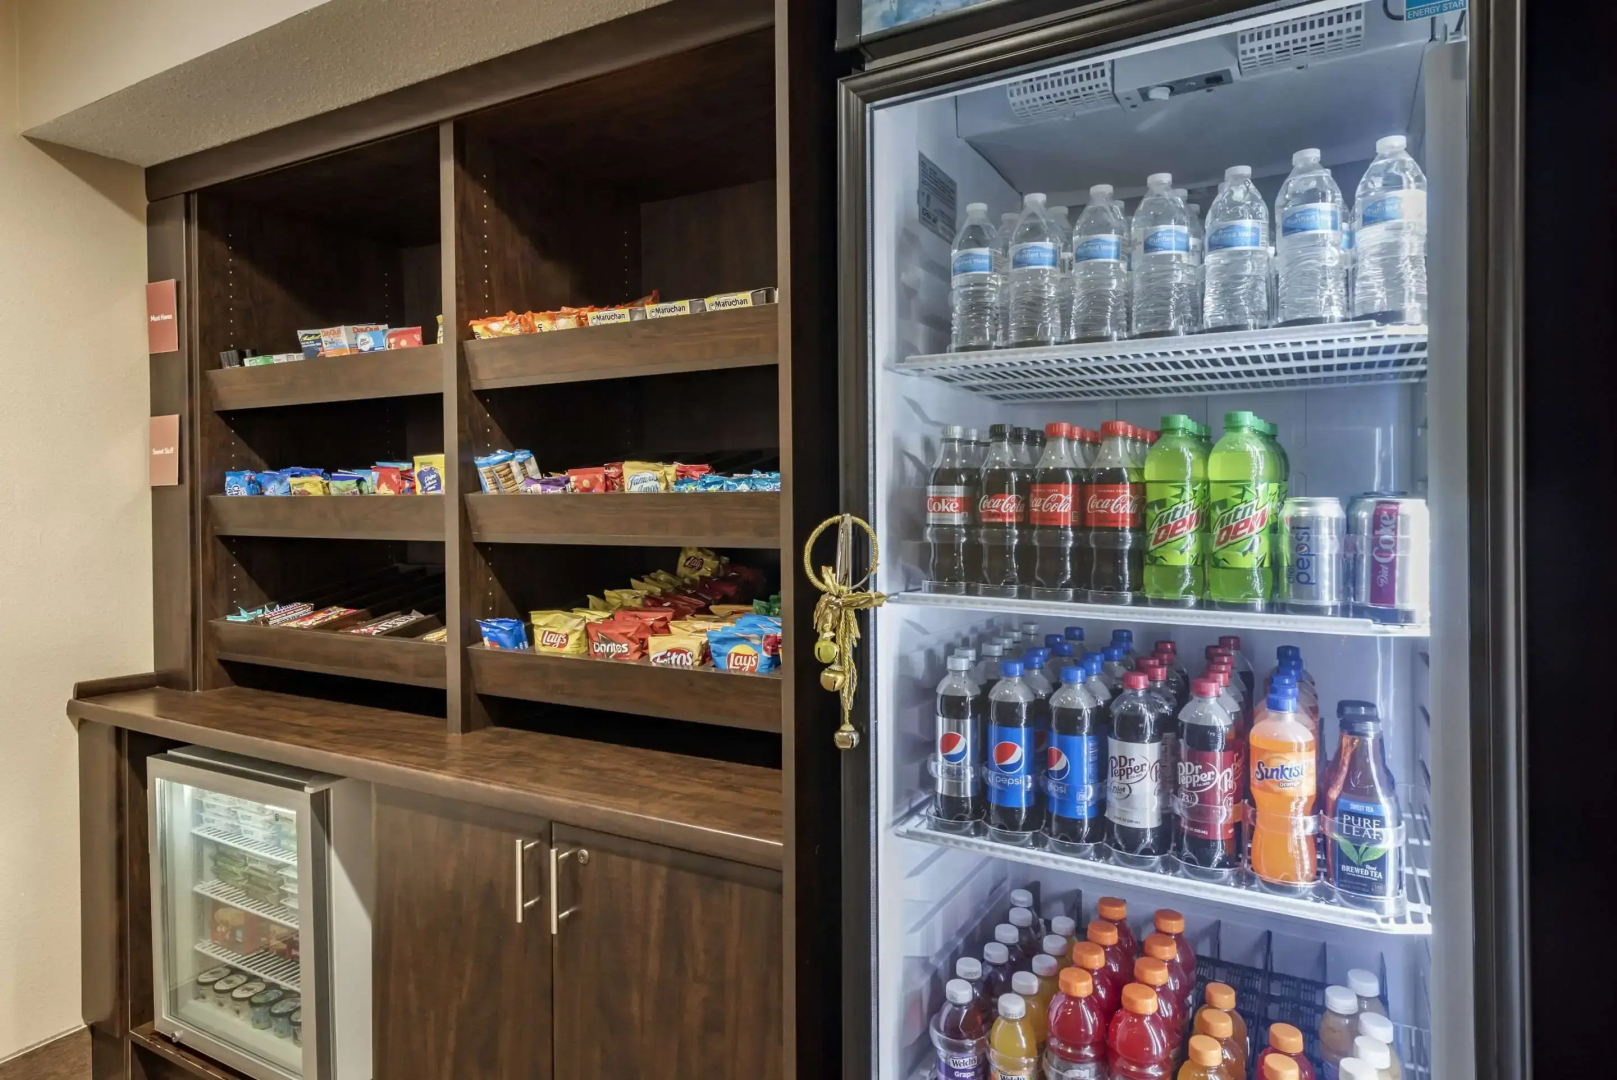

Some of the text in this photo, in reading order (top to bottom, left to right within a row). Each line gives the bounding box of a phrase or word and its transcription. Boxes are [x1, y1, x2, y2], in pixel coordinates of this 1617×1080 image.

[1408, 1, 1464, 19] ENERGY STAR
[655, 305, 686, 315] Maruchan
[714, 298, 748, 307] Maruchan
[596, 312, 626, 321] Maruchan
[627, 475, 658, 490] Famous
[927, 497, 959, 512] Coke
[979, 494, 1025, 513] Coca-Cola
[1087, 494, 1137, 513] Coca-Cola
[1292, 526, 1316, 585] pepsi
[1373, 512, 1396, 587] Diet Coke
[542, 630, 567, 648] Lay's
[593, 641, 629, 654] Doritos
[729, 653, 757, 671] Lay's
[1110, 756, 1147, 780] Pepper
[1118, 755, 1135, 767] Dr
[1185, 762, 1202, 774] Dr
[1178, 763, 1216, 787] Pepper
[1255, 760, 1304, 781] Sunkist
[995, 776, 1022, 790] pepsi
[1343, 814, 1381, 829] PURE
[1341, 864, 1369, 876] BREWED
[1370, 870, 1383, 880] TEA
[952, 1057, 977, 1068] Welch's
[954, 1071, 975, 1079] Grape
